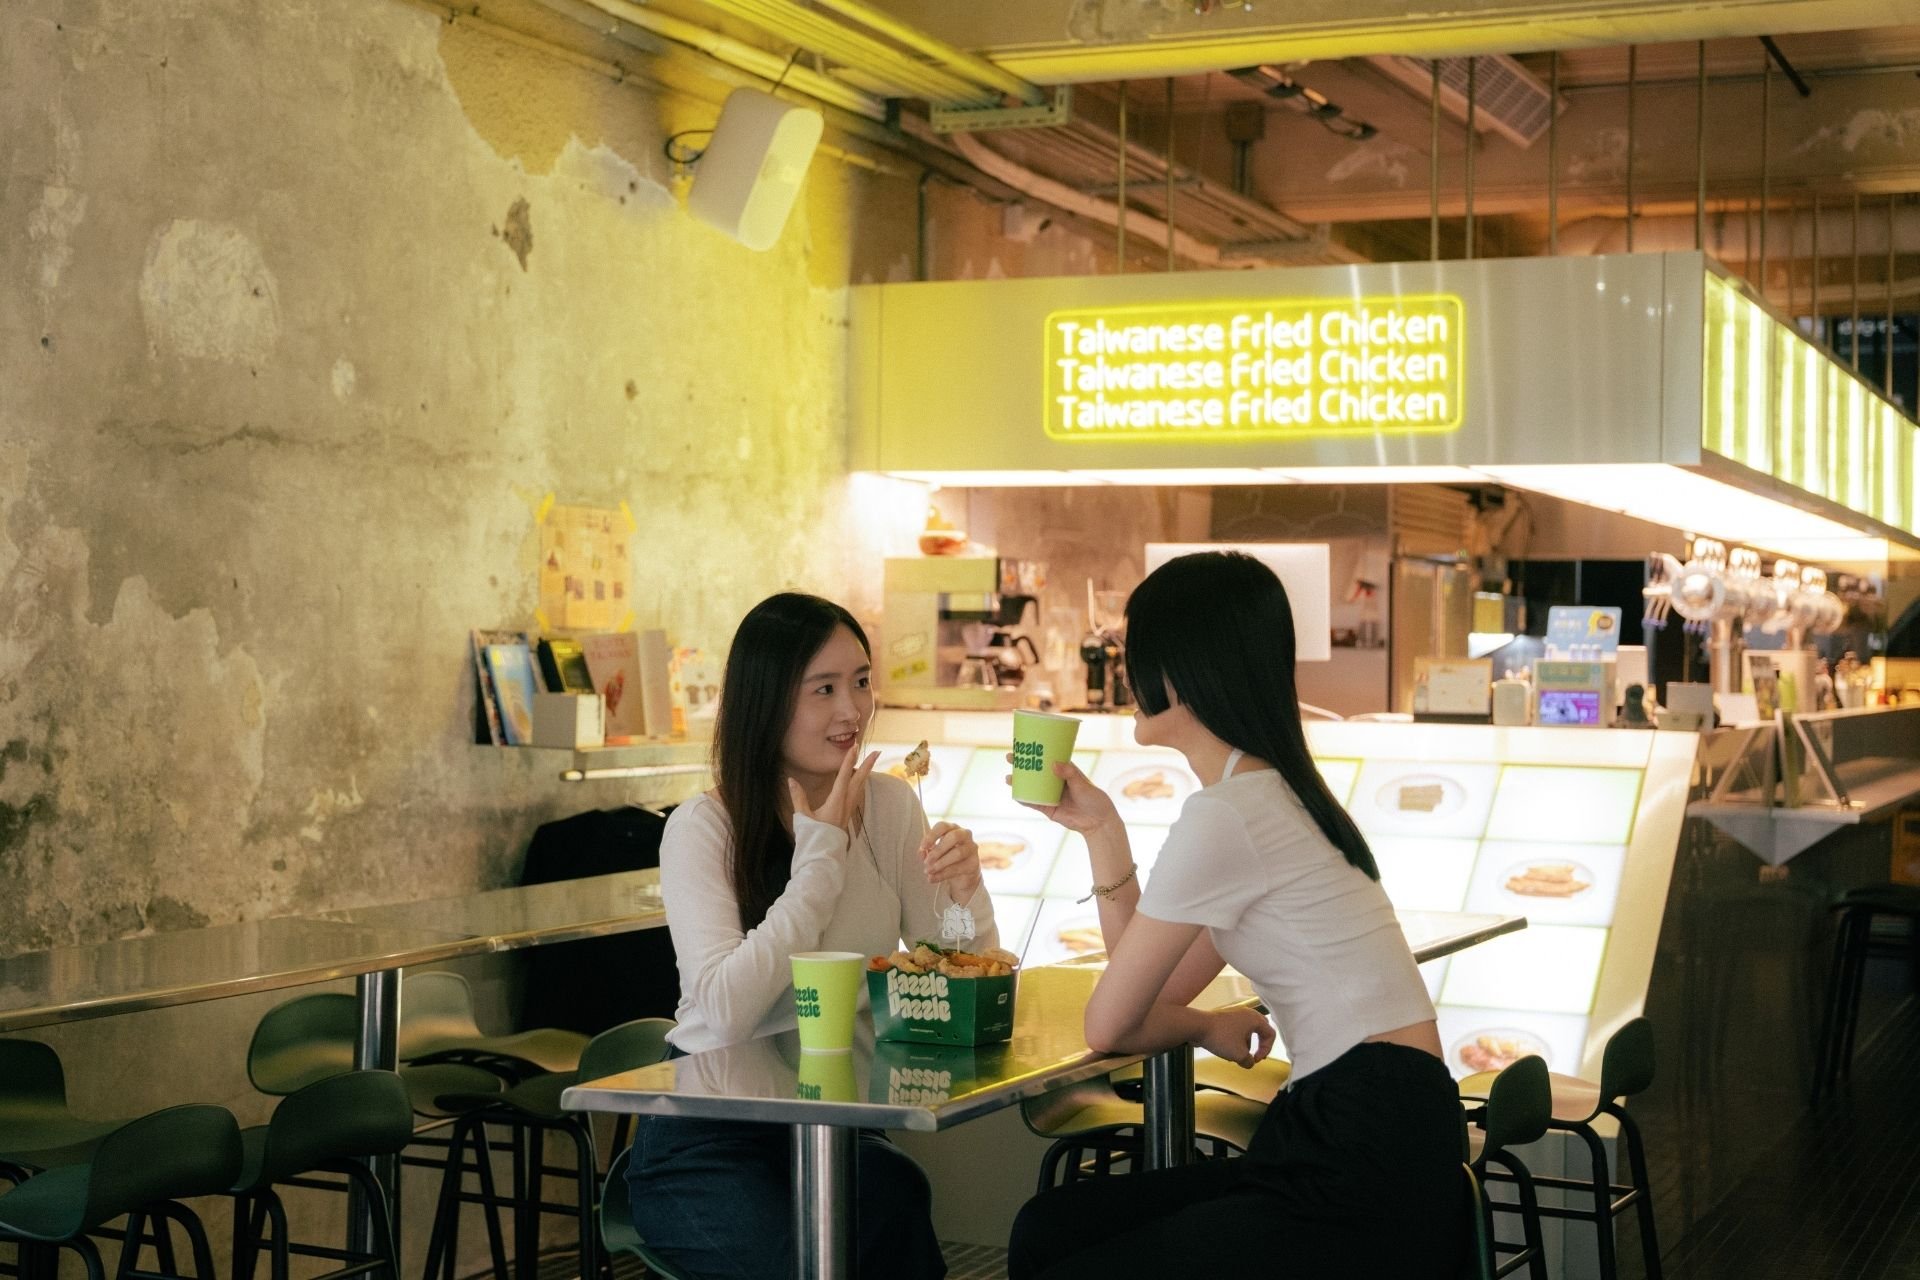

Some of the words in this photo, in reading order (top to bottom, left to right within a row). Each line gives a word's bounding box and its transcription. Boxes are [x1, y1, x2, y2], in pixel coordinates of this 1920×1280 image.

[1057, 319, 1224, 356] Taiwanese
[1230, 310, 1313, 351] Fried
[1319, 309, 1448, 347] Chicken
[1057, 355, 1224, 392] Taiwanese
[1230, 349, 1313, 388] Fried
[1319, 346, 1447, 385] Chicken
[1057, 392, 1224, 429] Taiwanese
[1229, 388, 1313, 425] Fried
[1319, 385, 1447, 423] Chicken
[1013, 738, 1044, 757] azzle
[1013, 755, 1043, 772] azzle
[886, 966, 949, 998] Razzle
[889, 992, 951, 1023] Dazzle
